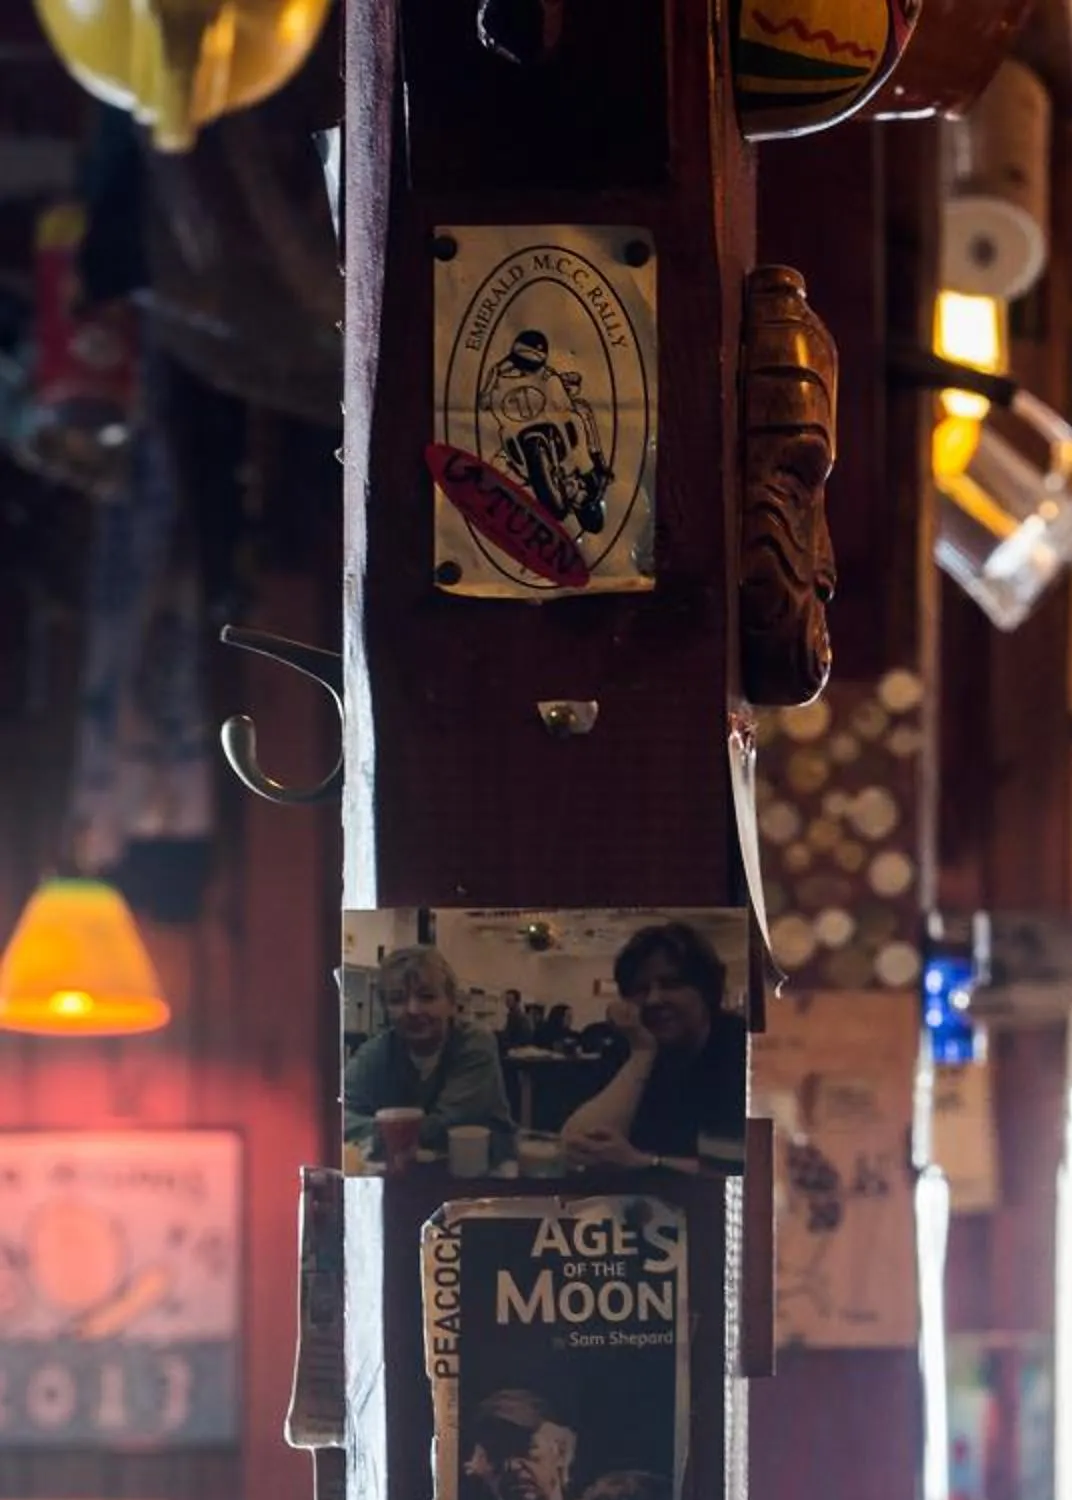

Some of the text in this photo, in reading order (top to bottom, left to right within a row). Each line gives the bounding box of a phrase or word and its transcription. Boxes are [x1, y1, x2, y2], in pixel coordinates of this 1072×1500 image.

[465, 265, 525, 351] EMERALD
[587, 287, 628, 349] RALLY
[531, 1206, 681, 1273] AGES
[563, 1262, 625, 1277] OF THE
[434, 1221, 461, 1378] PEACOCK
[496, 1270, 674, 1324] MOON
[568, 1332, 605, 1347] Sam
[609, 1331, 674, 1348] Shepard
